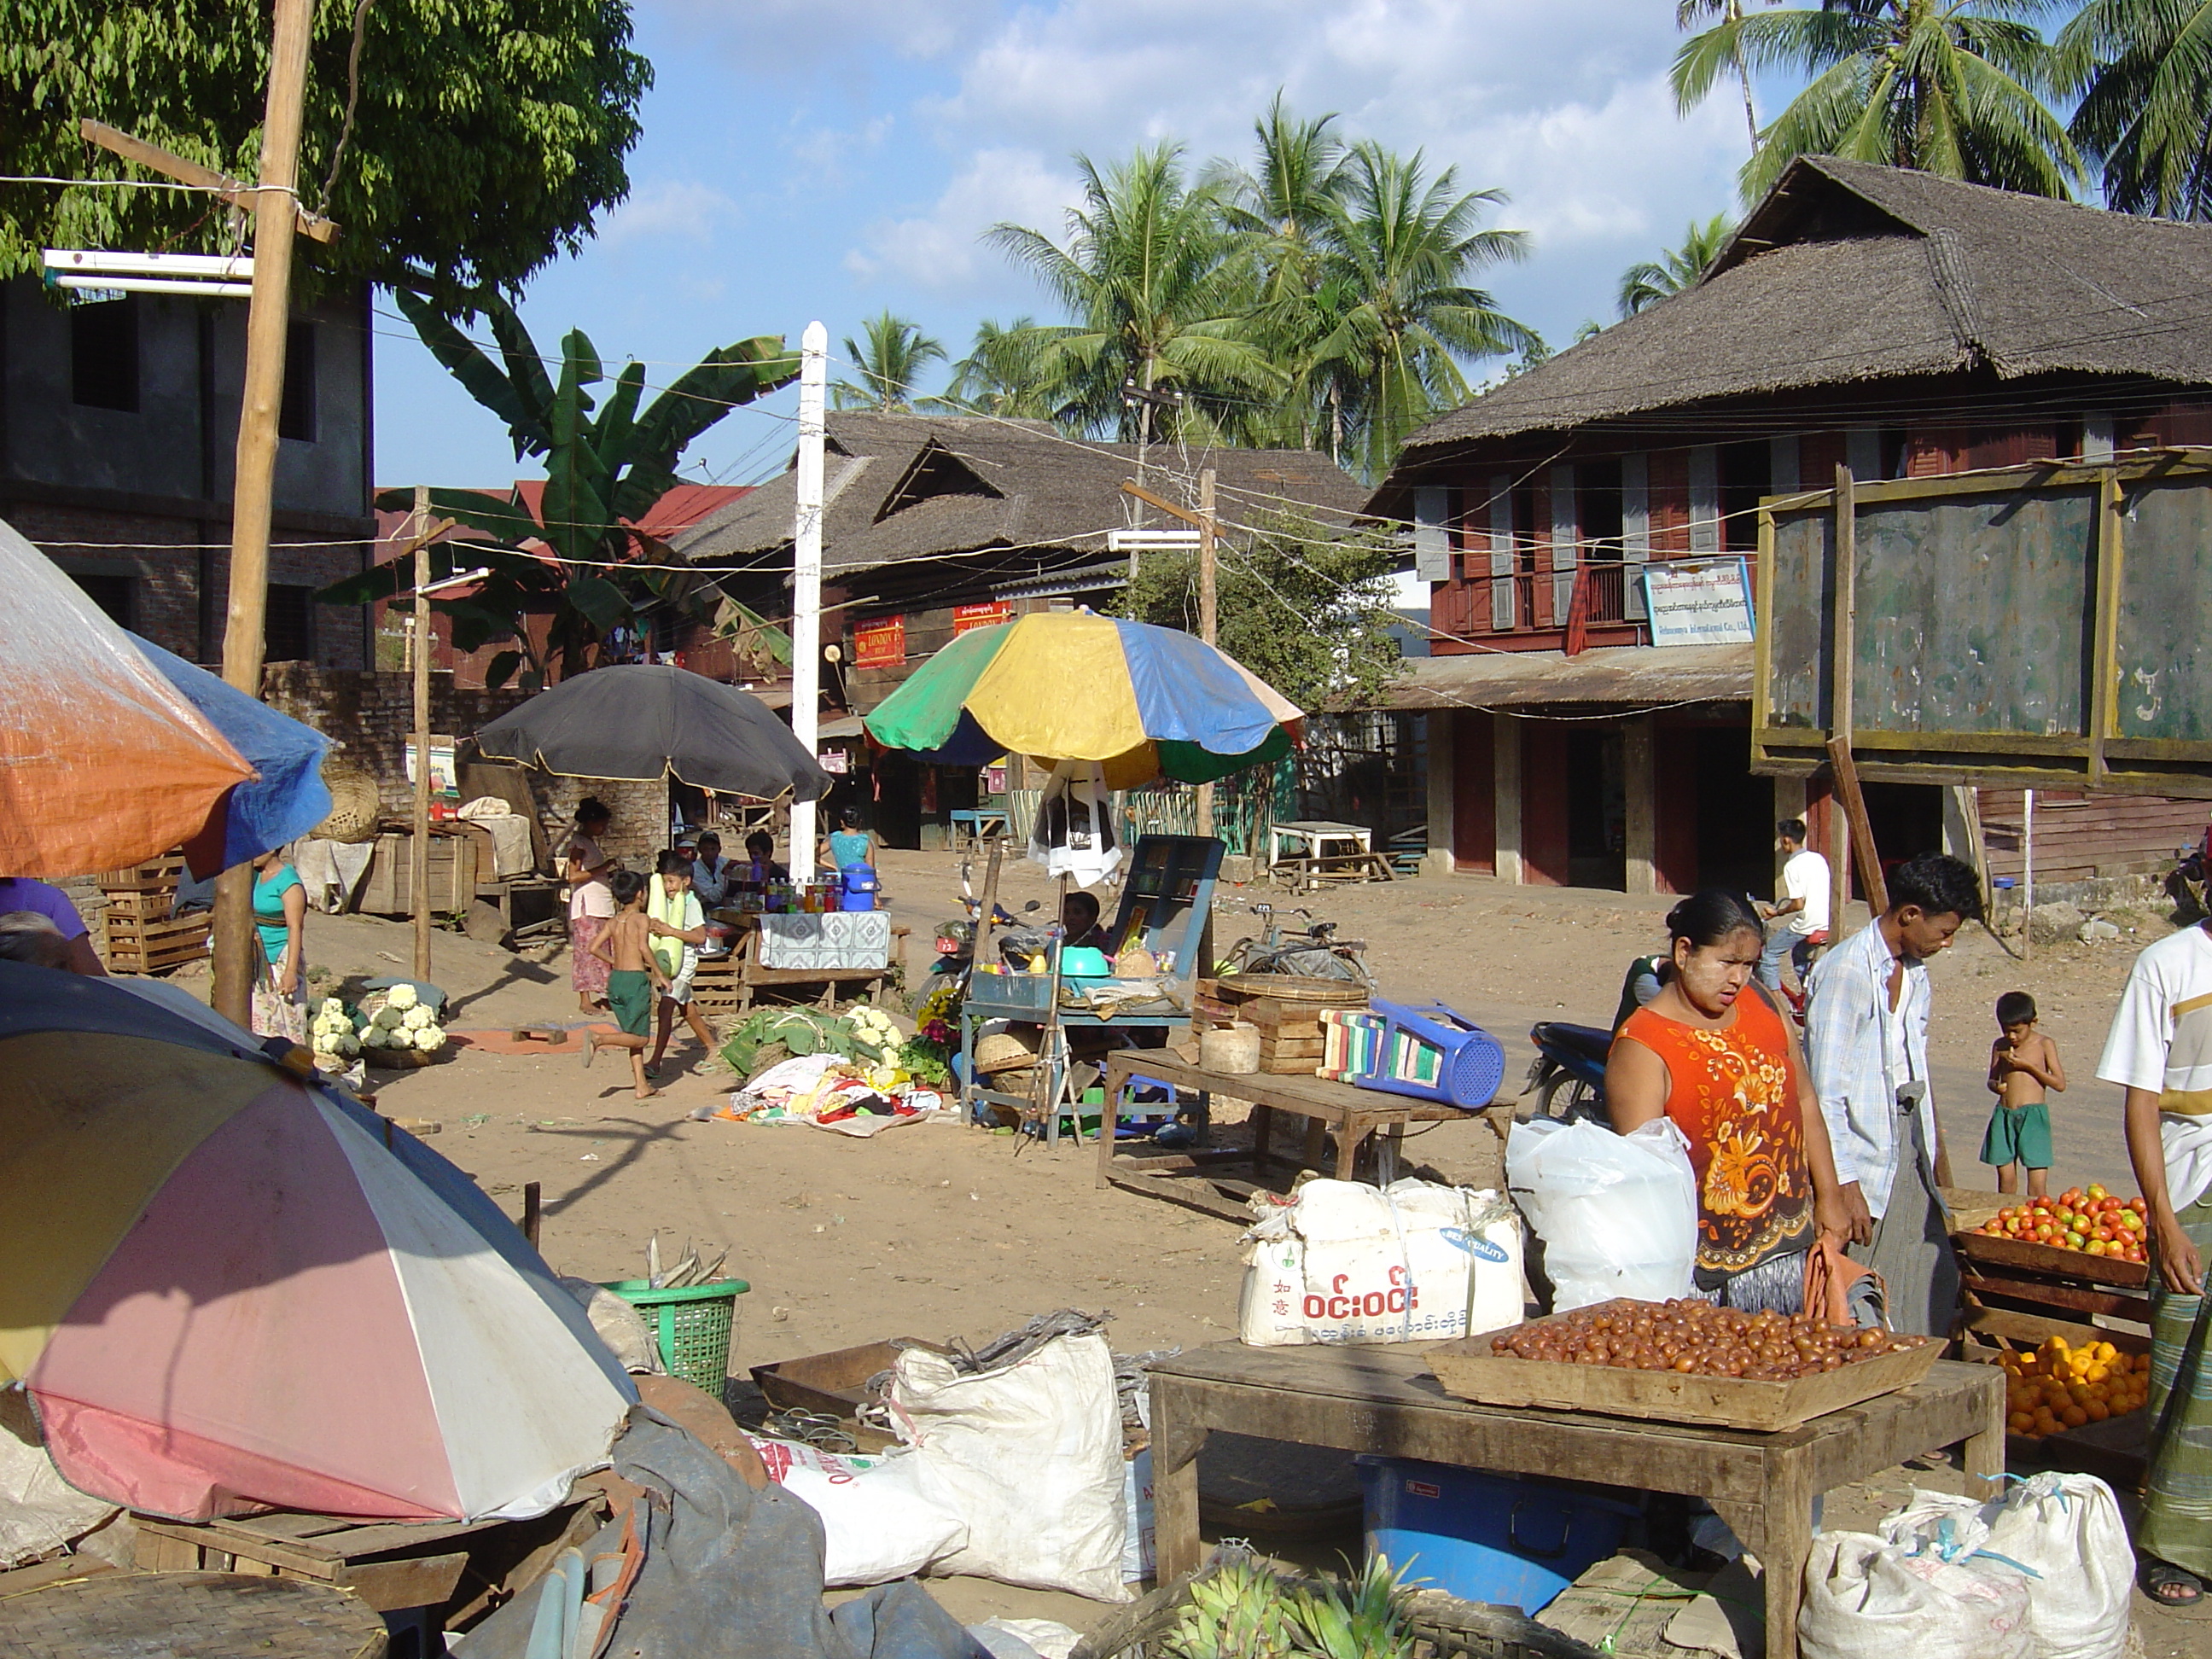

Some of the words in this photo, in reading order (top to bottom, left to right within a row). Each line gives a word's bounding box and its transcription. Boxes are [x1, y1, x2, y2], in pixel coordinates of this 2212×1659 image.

[868, 632, 892, 647] LONDON
[1446, 1230, 1468, 1243] BES
[1272, 1279, 1291, 1317] 如意
